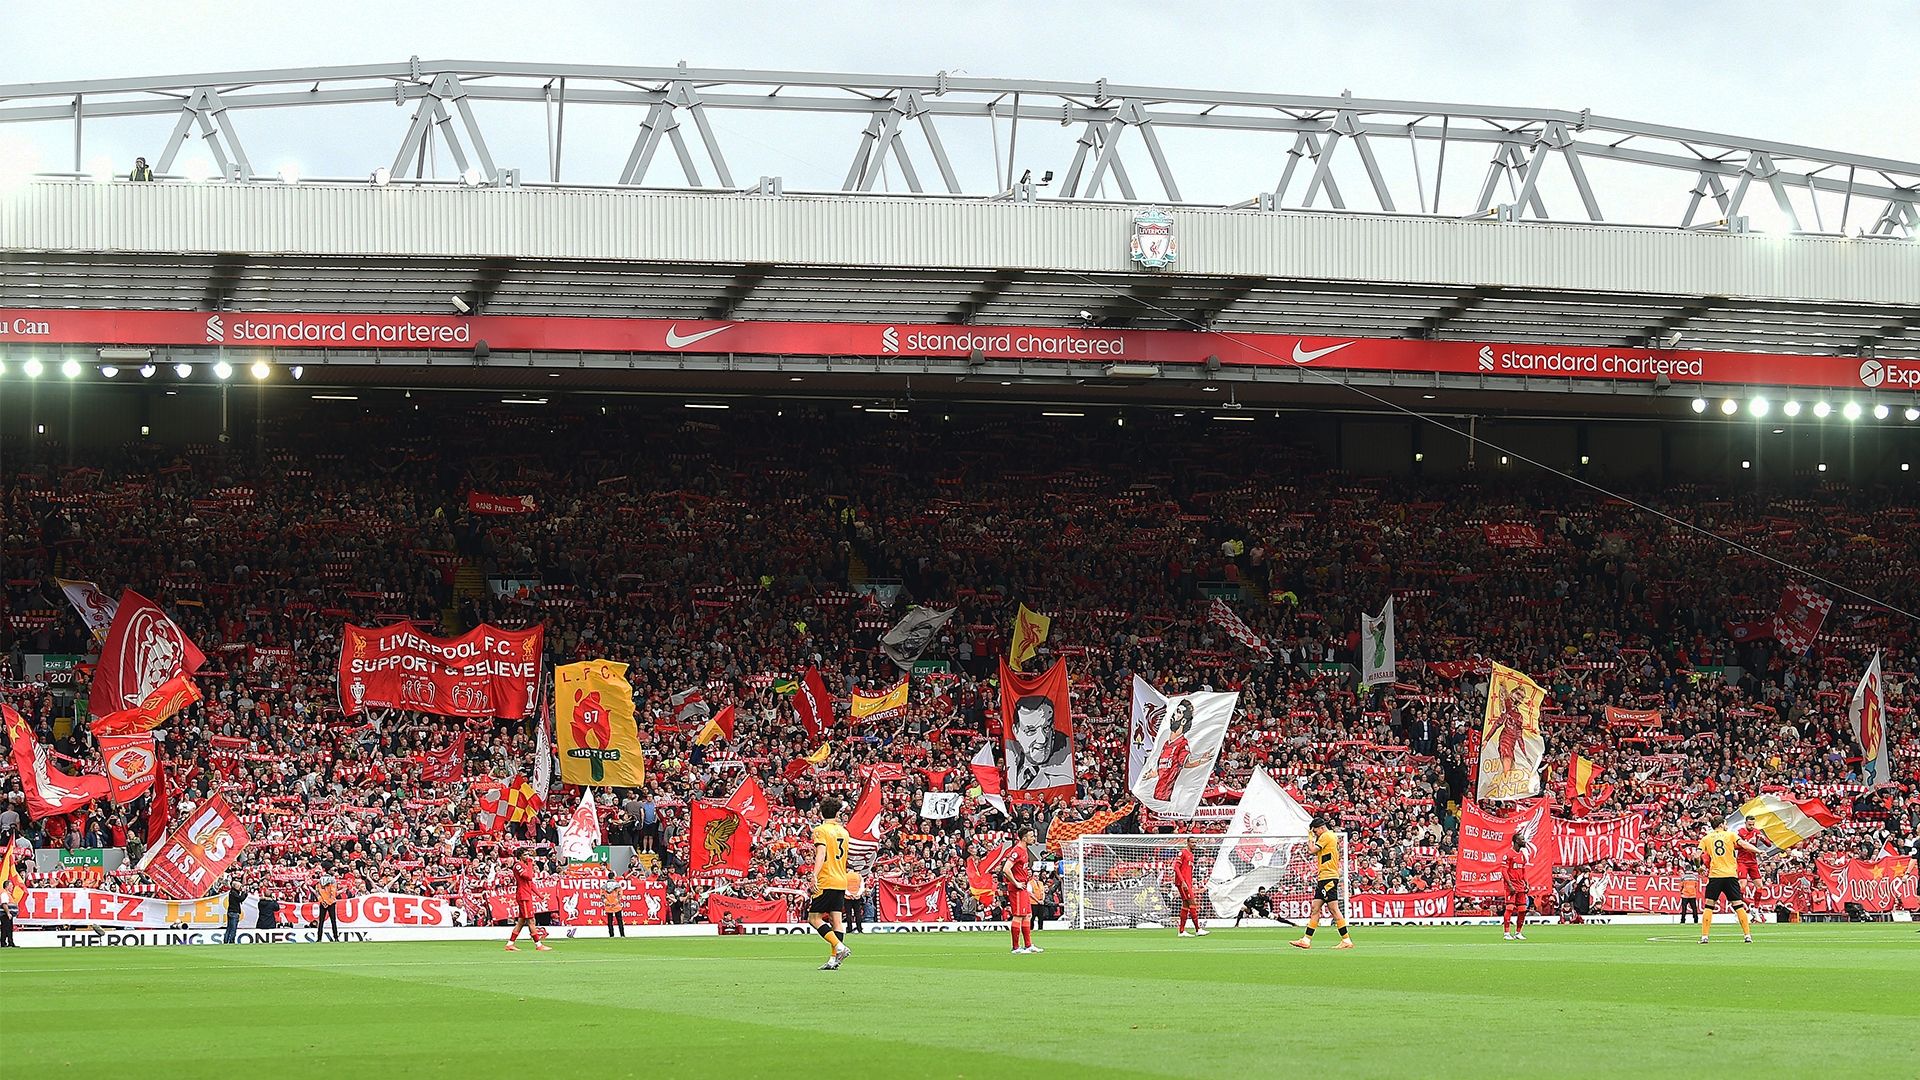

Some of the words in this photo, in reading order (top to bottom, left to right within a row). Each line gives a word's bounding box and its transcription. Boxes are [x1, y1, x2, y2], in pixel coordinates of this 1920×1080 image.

[13, 318, 50, 334] Can
[233, 319, 346, 342] standard
[352, 321, 470, 343] chartered
[907, 331, 1011, 353] standard
[1015, 333, 1125, 355] chartered
[1501, 350, 1598, 372] standard
[1602, 353, 1703, 376] chartered
[380, 632, 480, 659] LIVERPOOL
[484, 636, 515, 656] F.C.
[350, 655, 439, 674] SUPPORT
[444, 665, 459, 676] &
[463, 659, 536, 678] BELIEVE
[914, 666, 930, 674] EXIT
[51, 673, 72, 684] 207
[584, 710, 599, 724] 97
[571, 749, 618, 760] JUSTICE
[1199, 808, 1217, 817] WALK
[1465, 825, 1479, 838] THIS
[1481, 829, 1504, 842] EARTH
[835, 838, 845, 860] 3
[1463, 848, 1479, 861] THIS
[1481, 851, 1497, 863] LAND
[1557, 836, 1594, 867] WIN
[1596, 834, 1646, 862] CUPS
[1714, 840, 1726, 856] 8
[63, 857, 83, 865] EXIT
[712, 868, 724, 877] YOU
[724, 868, 744, 878] MORE
[1461, 870, 1477, 882] THIS
[1478, 872, 1487, 882] IS
[1608, 875, 1637, 891] WE
[1645, 876, 1681, 892] ARE
[1321, 889, 1327, 898] 9
[276, 895, 443, 925] ROUGES
[894, 894, 913, 918] H
[1371, 900, 1405, 919] LAW
[1413, 896, 1449, 918] NOW
[1608, 895, 1640, 910] THE
[57, 934, 100, 947] THE
[107, 933, 204, 947] ROLLING
